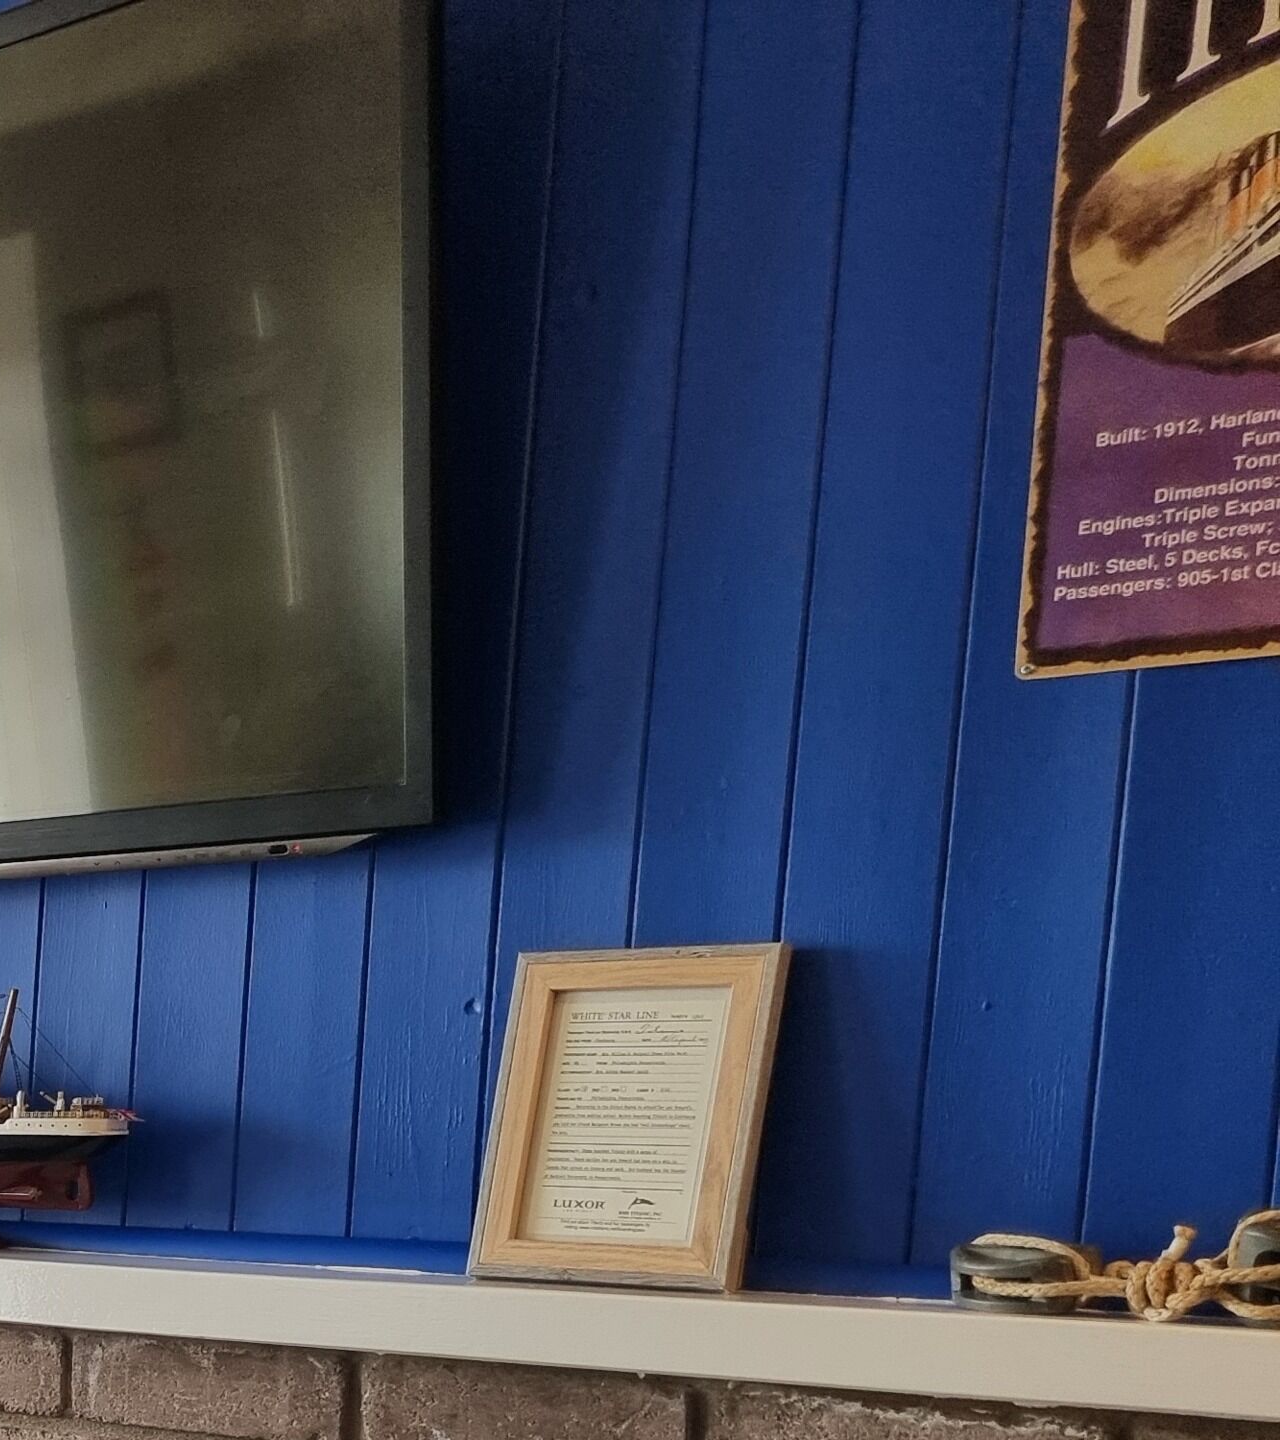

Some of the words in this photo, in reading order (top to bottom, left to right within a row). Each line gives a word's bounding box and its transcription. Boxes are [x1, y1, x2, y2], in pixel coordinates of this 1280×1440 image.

[1096, 428, 1147, 447] Built:
[1153, 419, 1204, 439] 1912,
[1142, 528, 1198, 548] Triple
[1056, 561, 1100, 580] Hull:
[1105, 554, 1159, 575] Steel,
[1164, 551, 1177, 568] 5
[1182, 545, 1248, 565] Decks,
[1054, 575, 1173, 601] Passengers:
[1177, 567, 1250, 588] 905-1st
[553, 1199, 607, 1210] LUXOR
